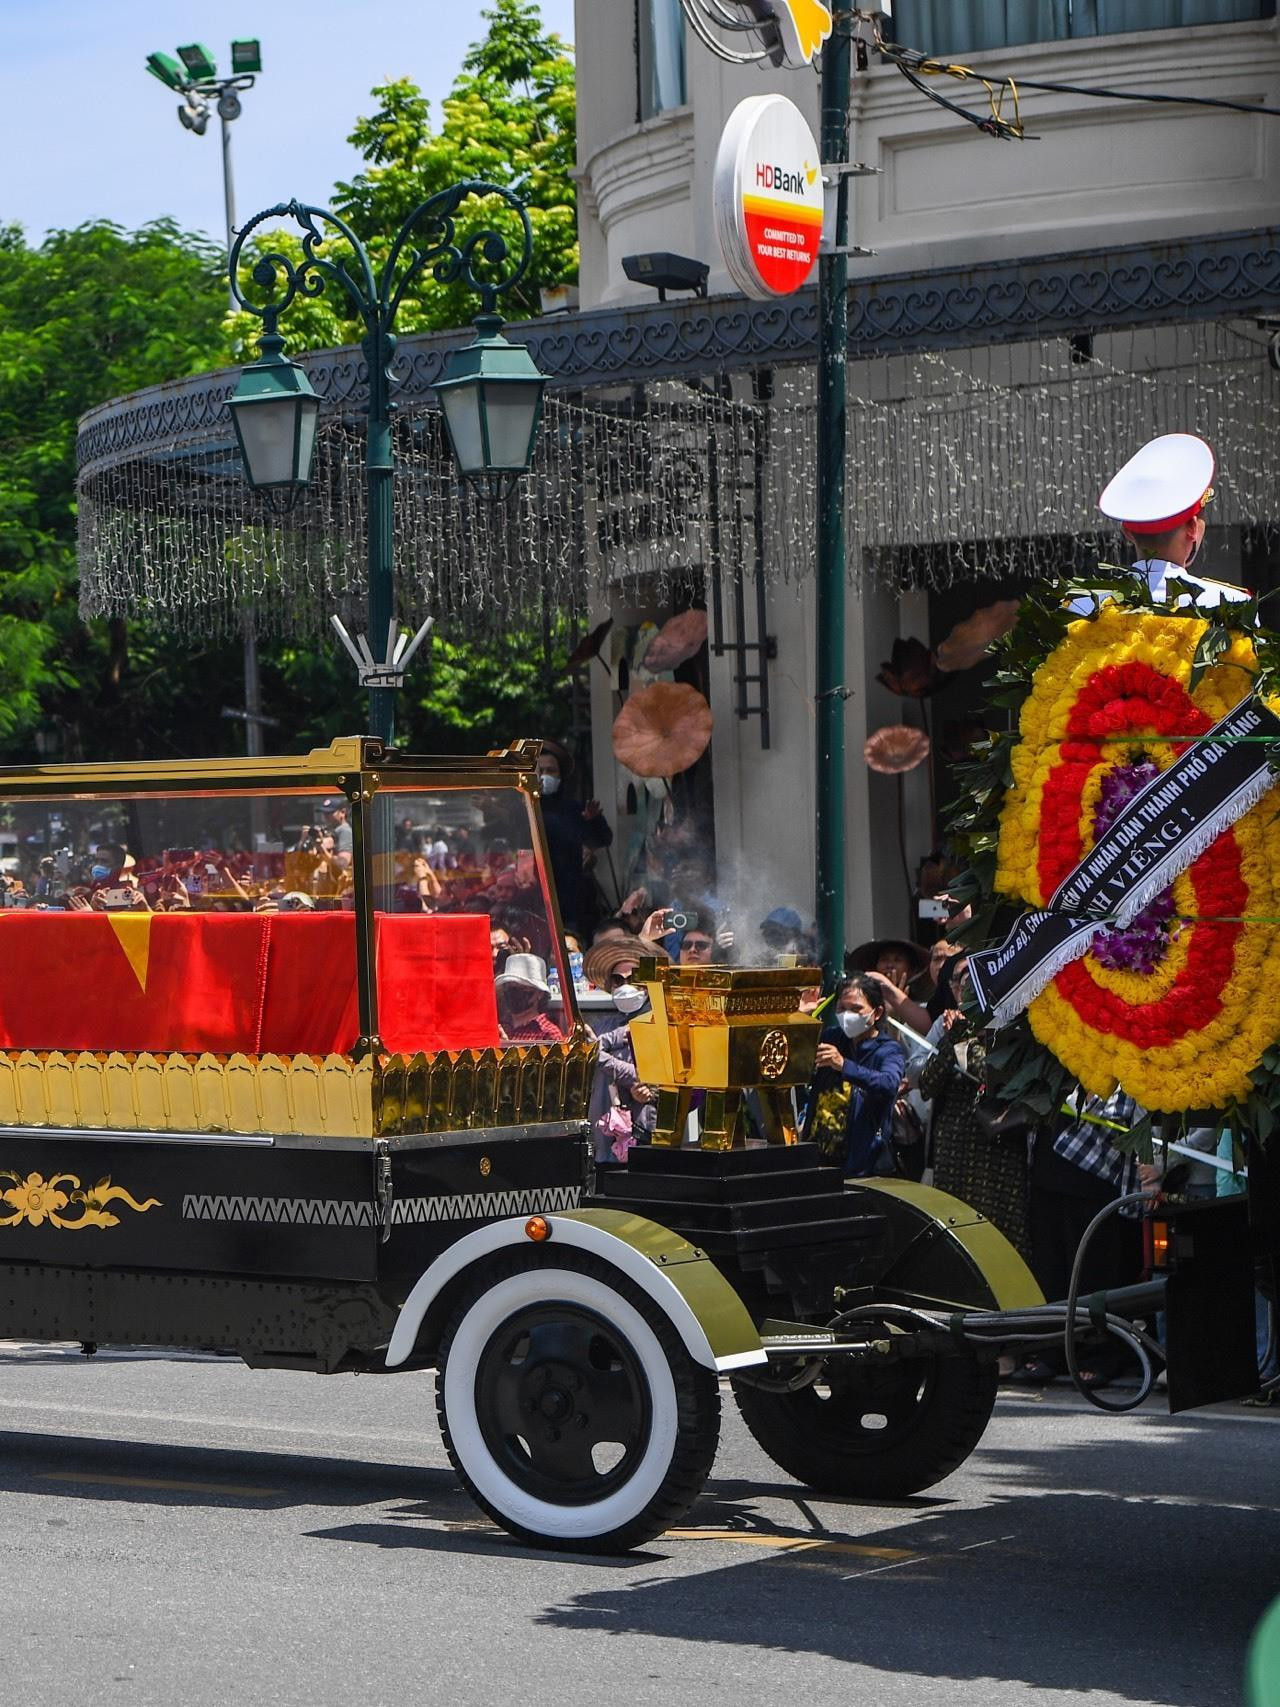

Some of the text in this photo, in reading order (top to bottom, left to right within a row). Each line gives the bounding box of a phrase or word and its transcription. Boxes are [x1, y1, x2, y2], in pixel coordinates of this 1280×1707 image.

[756, 162, 804, 195] HDBank
[764, 227, 805, 246] COMMITTED TO
[757, 243, 811, 264] YOUR BEST RETURNS
[987, 945, 1015, 976] ĐẢNG
[1074, 871, 1094, 893] VÀ
[1087, 840, 1122, 878] NHÂN
[1115, 816, 1146, 847] DÂN
[1138, 780, 1183, 822] THÀNH
[1176, 752, 1208, 787] PHỐ
[1108, 819, 1182, 889] VIẾNG
